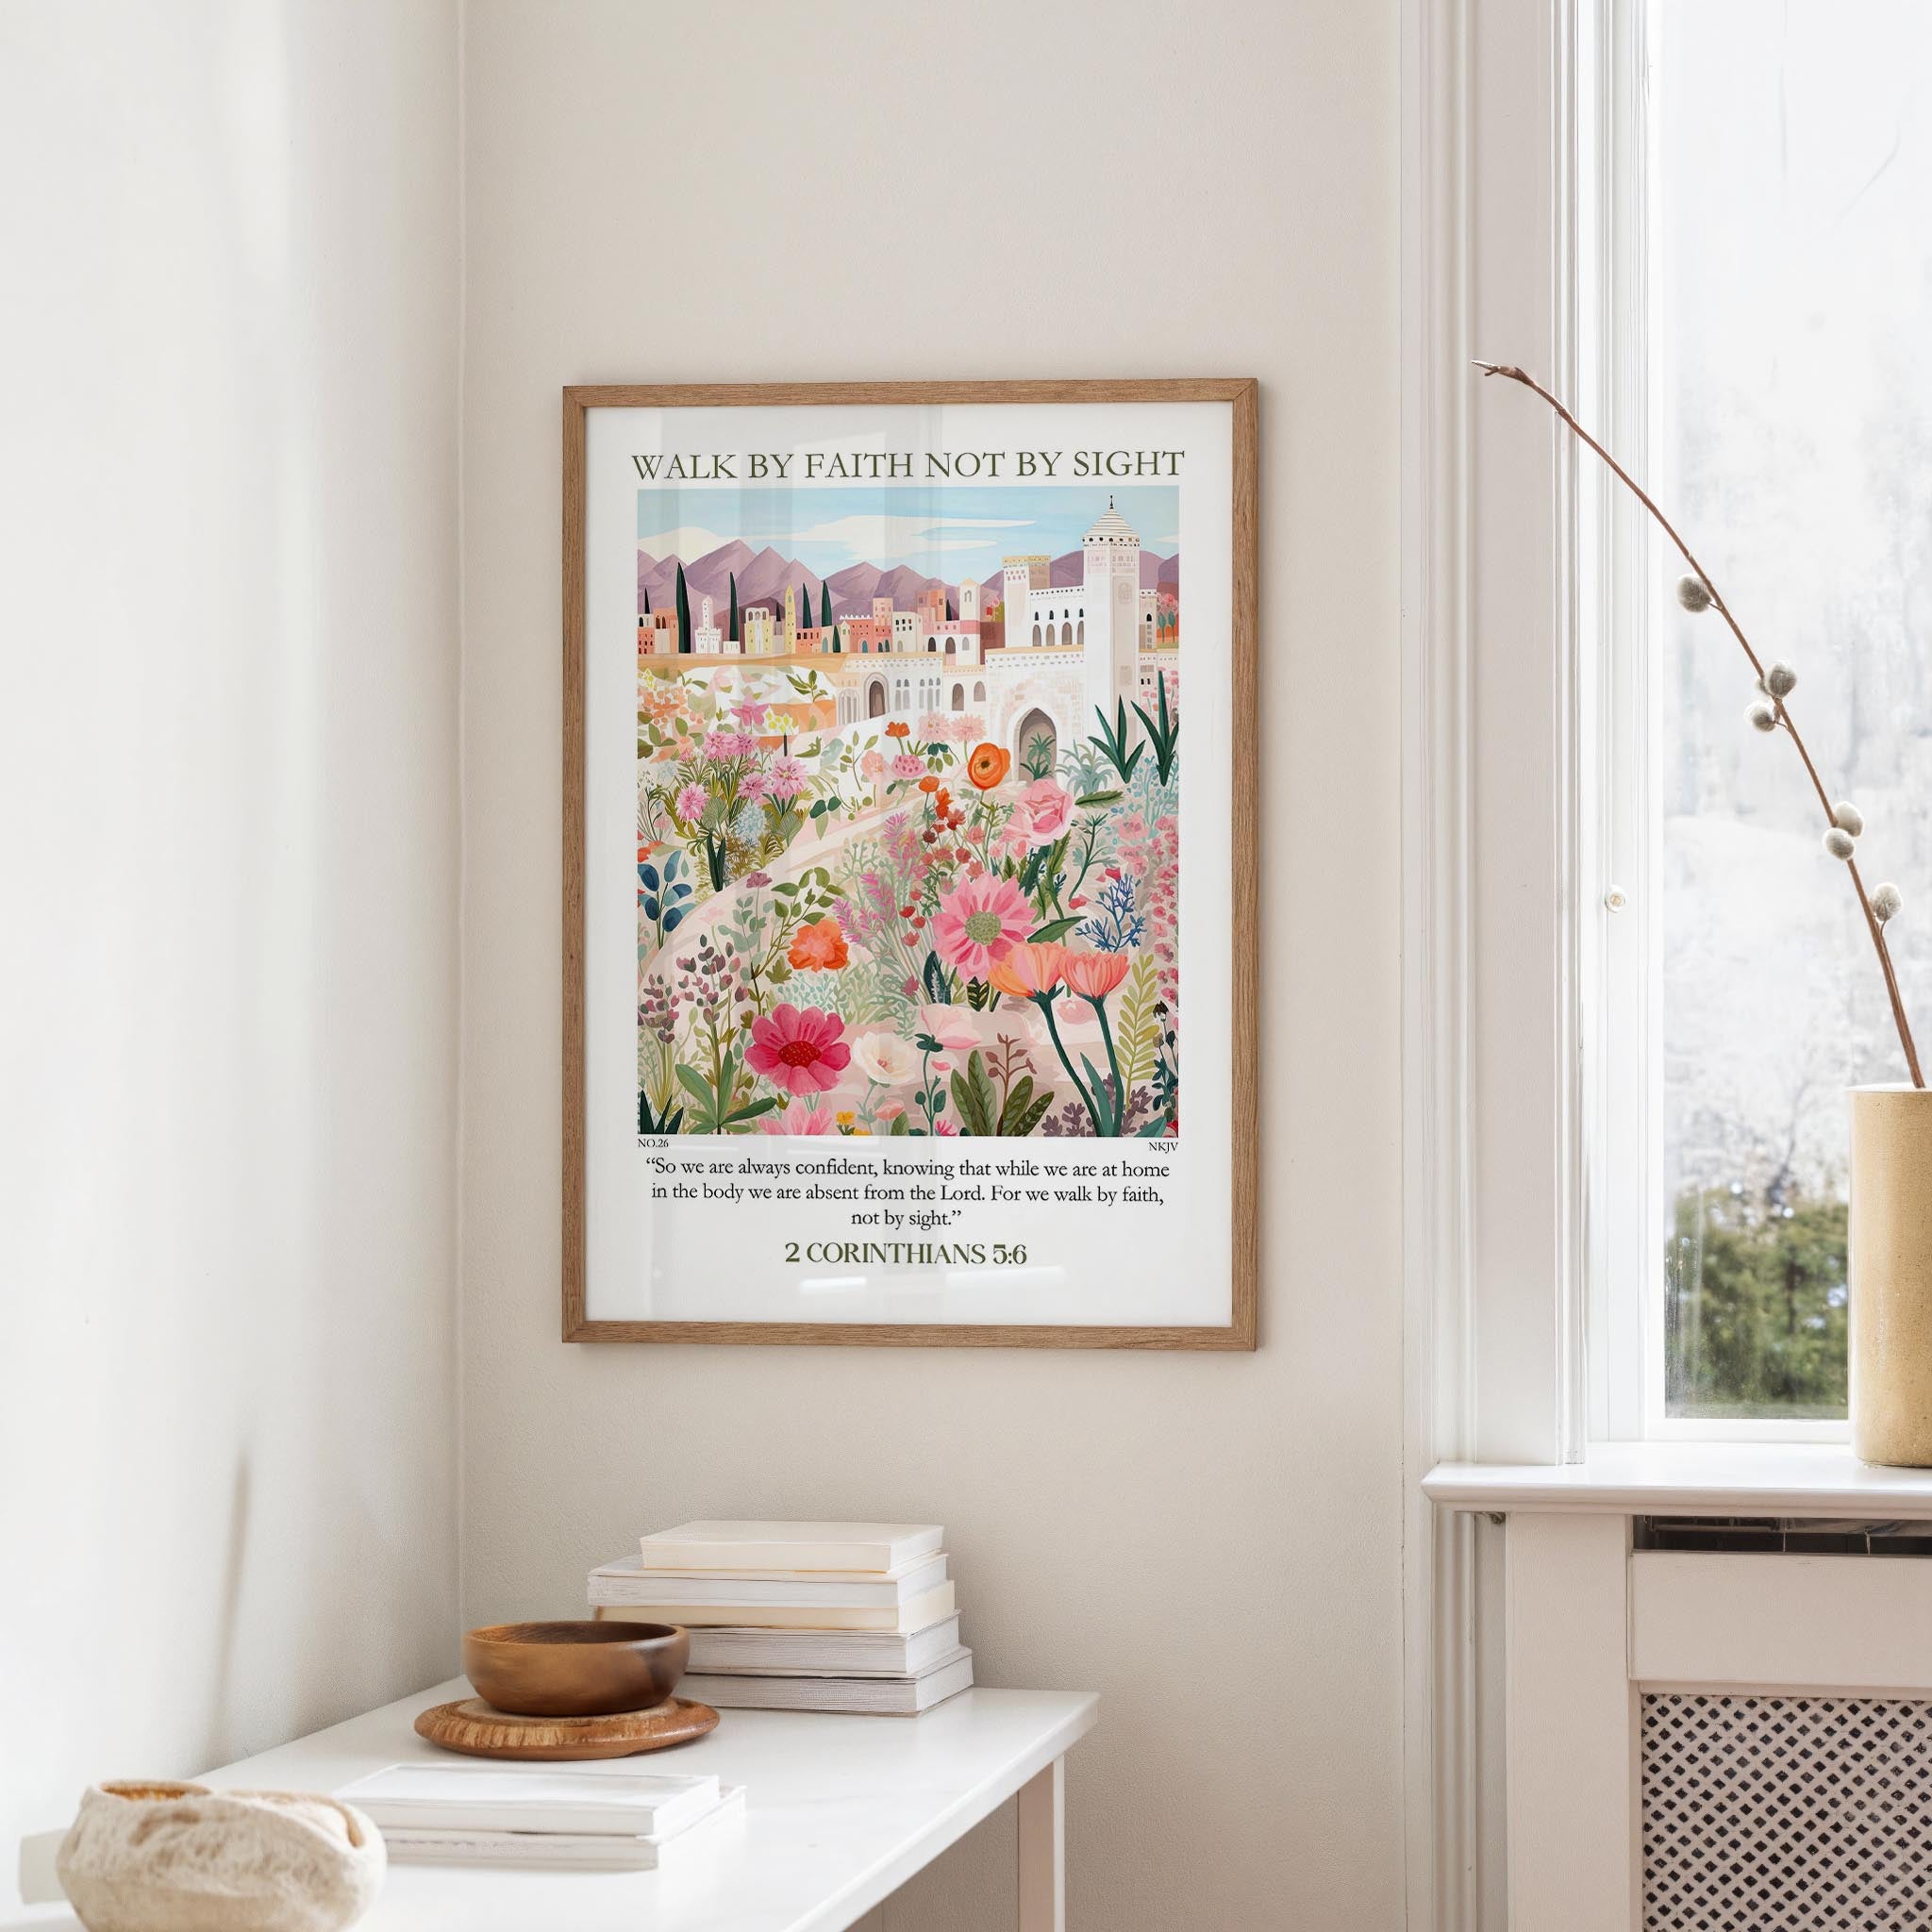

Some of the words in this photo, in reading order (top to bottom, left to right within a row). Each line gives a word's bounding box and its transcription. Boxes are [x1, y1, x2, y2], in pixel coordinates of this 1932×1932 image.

[630, 453, 738, 481] WALK
[746, 453, 795, 479] BY
[804, 452, 914, 479] FAITH
[924, 451, 1006, 478] NOT
[1015, 451, 1064, 477] BY
[1074, 449, 1186, 477] SIGHT
[637, 1138, 669, 1148] NO.26
[1148, 1141, 1178, 1152] NKJV
[645, 1157, 676, 1174] “So
[679, 1162, 705, 1174] we
[708, 1162, 734, 1174] are
[737, 1157, 791, 1180] always
[794, 1158, 879, 1179] confident,
[882, 1158, 956, 1182] knowing
[958, 1158, 992, 1176] that
[994, 1158, 1041, 1177] while
[1042, 1165, 1069, 1177] we
[1072, 1165, 1098, 1177] are
[1101, 1163, 1119, 1177] at
[1121, 1159, 1171, 1178] home
[651, 1182, 669, 1199] in
[672, 1182, 698, 1199] the
[702, 1182, 745, 1205] body
[747, 1188, 773, 1200] we
[775, 1188, 802, 1200] are
[805, 1183, 860, 1201] absent
[863, 1183, 906, 1201] from
[908, 1184, 937, 1201] the
[940, 1184, 986, 1202] Lord.
[990, 1184, 1023, 1202] For
[1024, 1190, 1050, 1202] we
[1053, 1185, 1094, 1203] walk
[1096, 1185, 1119, 1208] by
[1122, 1185, 1164, 1207] faith,
[850, 1211, 880, 1225] not
[883, 1208, 906, 1231] by
[908, 1208, 962, 1232] sight.”
[784, 1241, 801, 1263] 2
[806, 1241, 987, 1265] CORINTHIANS
[992, 1243, 1027, 1266] 5:6
